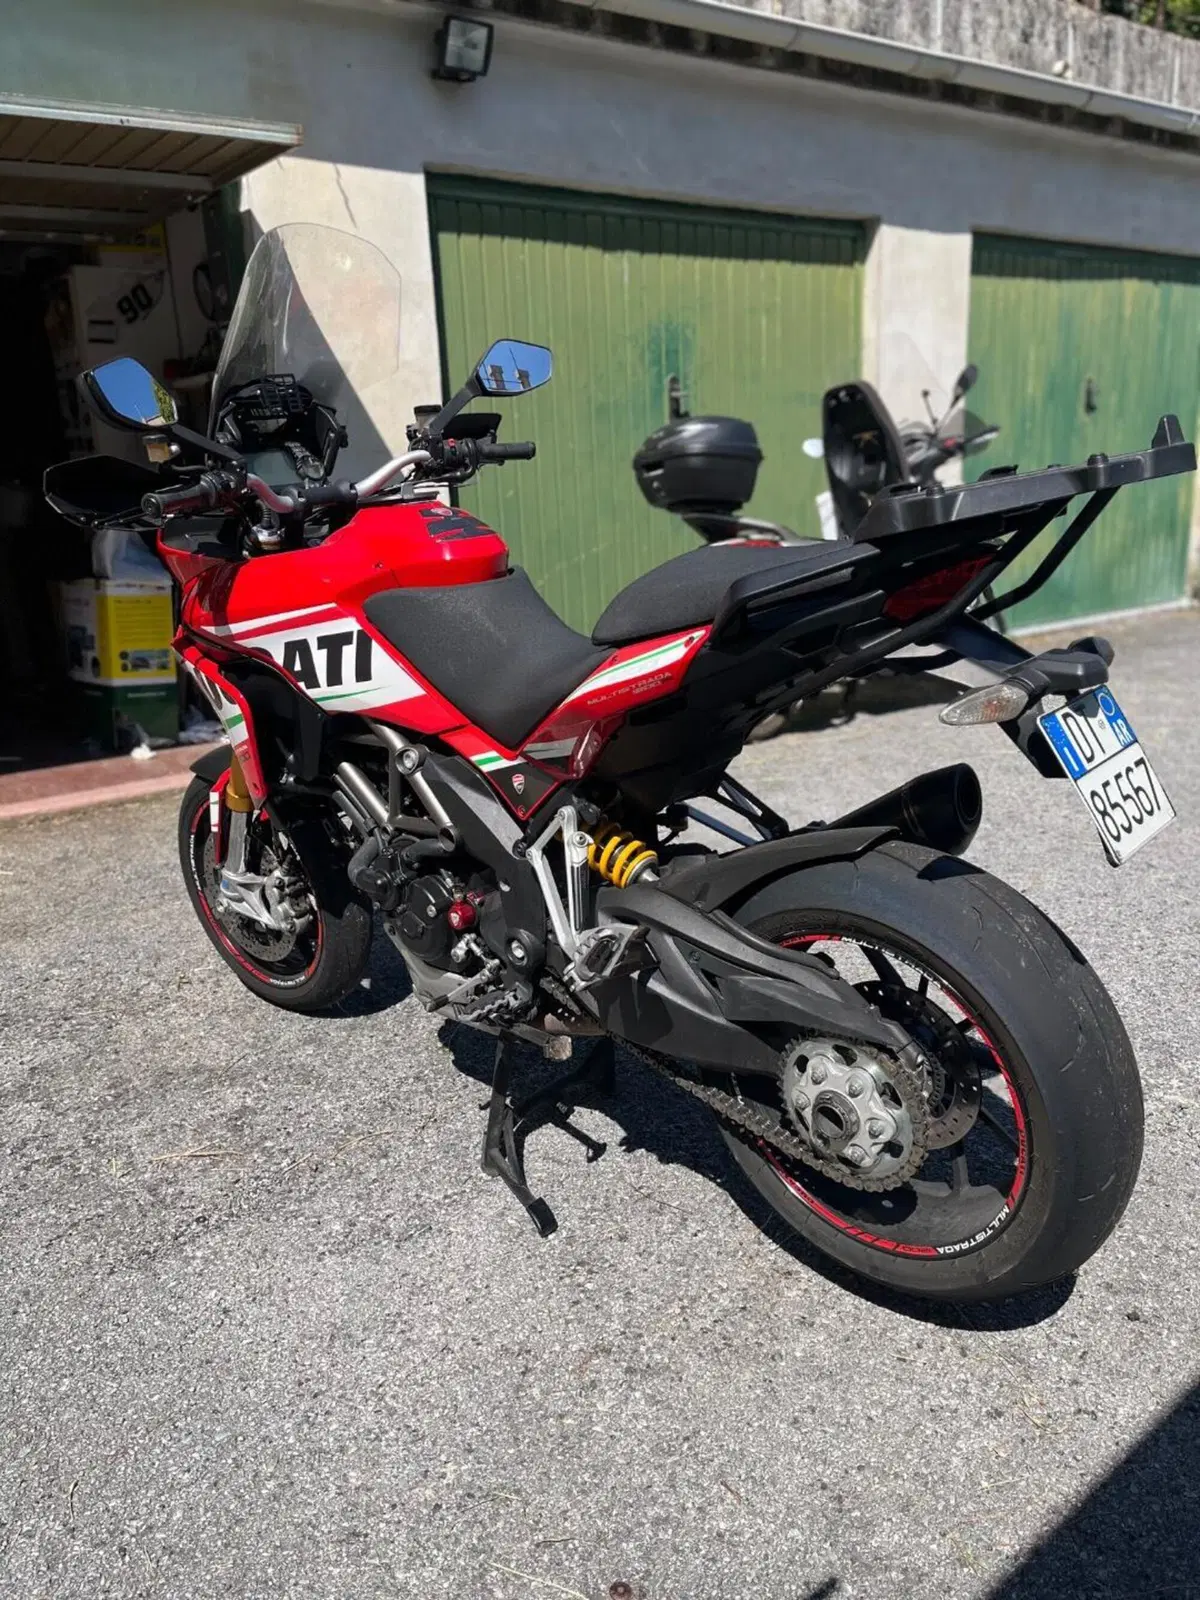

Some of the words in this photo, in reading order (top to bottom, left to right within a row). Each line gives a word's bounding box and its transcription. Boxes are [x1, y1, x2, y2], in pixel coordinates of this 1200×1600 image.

[116, 283, 153, 325] 90
[252, 629, 373, 690] ATI
[586, 671, 673, 706] MULTISTRADA
[1061, 703, 1106, 764] DT
[1112, 719, 1134, 748] AR
[1089, 757, 1162, 843] 85567
[936, 1204, 1011, 1255] MULTISTRADA
